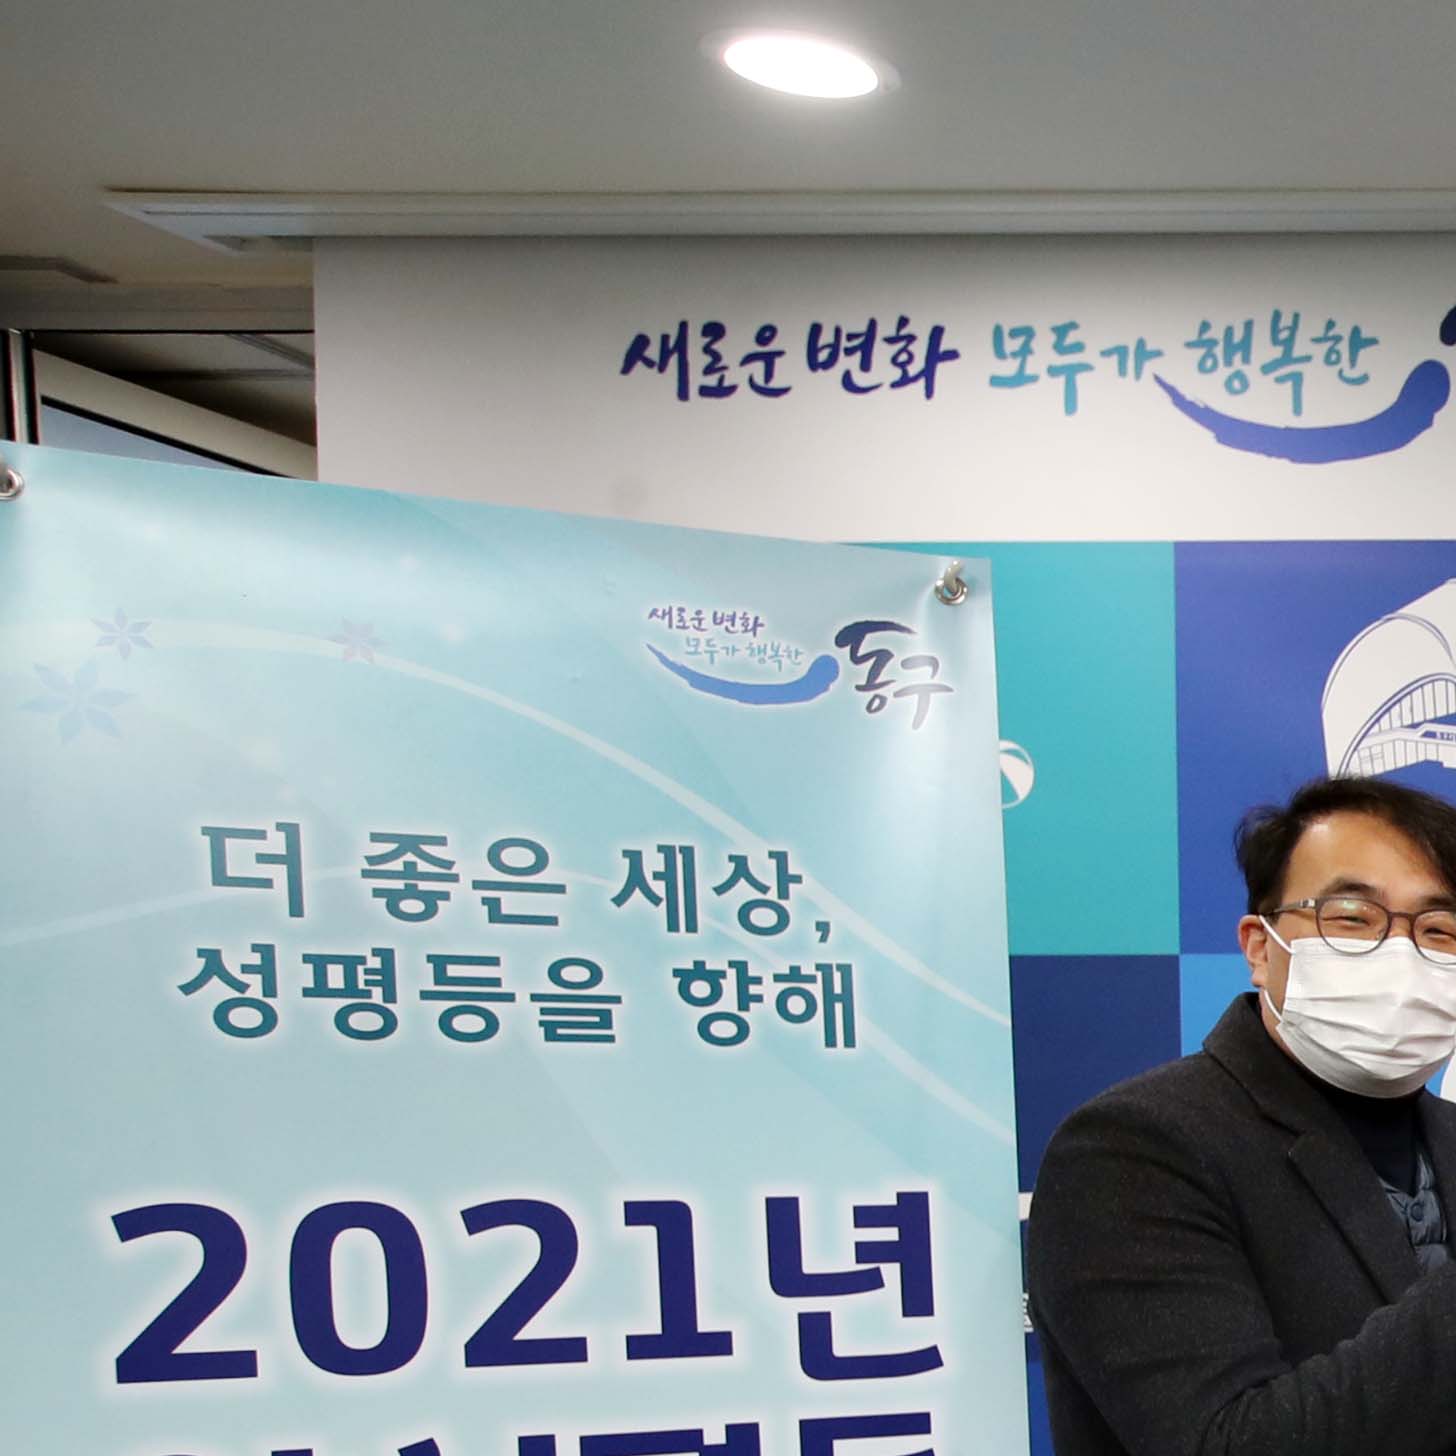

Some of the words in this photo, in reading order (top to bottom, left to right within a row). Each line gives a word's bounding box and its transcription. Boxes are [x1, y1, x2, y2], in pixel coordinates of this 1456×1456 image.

[620, 319, 792, 402] 새로운
[806, 315, 960, 400] 변화
[989, 321, 1164, 416] 모두가
[1183, 309, 1379, 416] 행복한
[647, 605, 710, 633] 새로운
[711, 609, 766, 638] 변화
[834, 619, 955, 731] 동구
[684, 636, 741, 666] 모두가
[745, 641, 805, 673] 행복한
[199, 821, 307, 919] 더
[358, 830, 569, 928] 좋은
[608, 842, 834, 945] 세상,
[176, 942, 624, 1045] 성평등을
[671, 958, 858, 1050] 향해
[110, 1190, 945, 1384] 2021년
